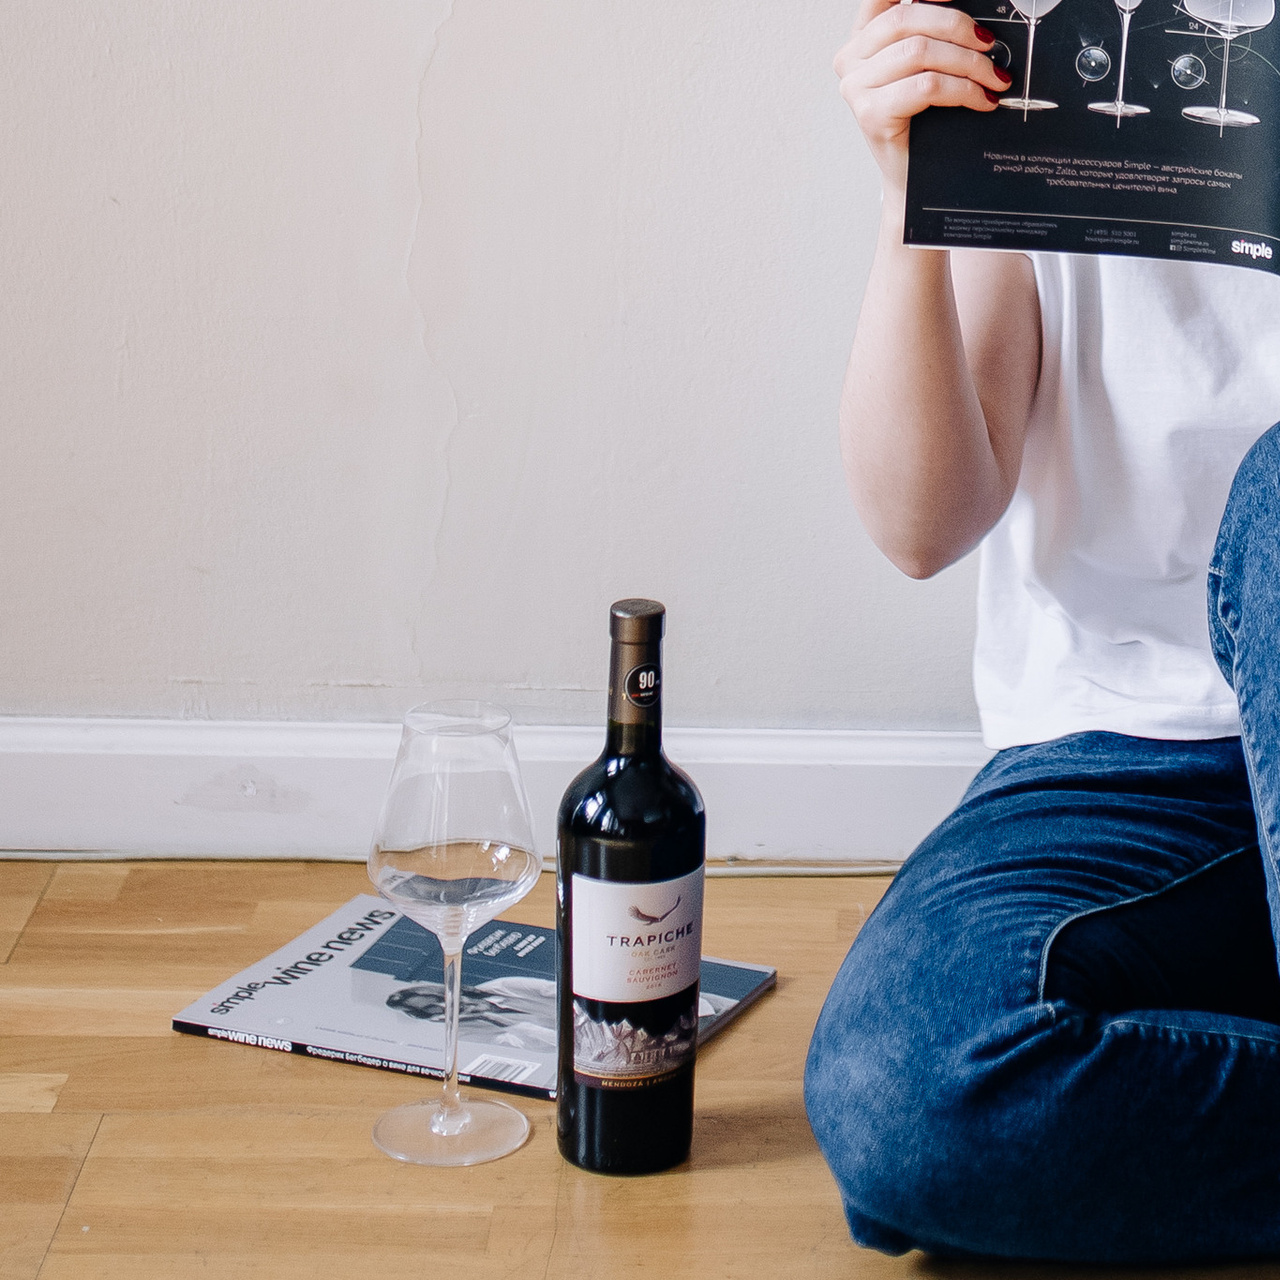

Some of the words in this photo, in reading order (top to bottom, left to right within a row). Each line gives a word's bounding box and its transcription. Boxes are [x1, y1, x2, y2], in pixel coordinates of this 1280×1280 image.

[983, 151, 1019, 161] Новинка
[1027, 155, 1071, 164] коллекции
[1072, 158, 1122, 168] аксессуаров
[1124, 160, 1151, 171] Simple
[1161, 165, 1212, 176] австрийские
[1214, 168, 1243, 180] бокалы
[993, 164, 1022, 173] ручной
[1025, 165, 1054, 174] работы
[1115, 172, 1169, 183] удовлетворят
[1171, 176, 1205, 186] запросы
[1207, 180, 1231, 189] самых
[1046, 177, 1111, 189] требовательных
[1231, 239, 1273, 260] simple
[639, 671, 655, 689] 90
[606, 921, 694, 947] TRAPICHE
[210, 982, 266, 1015] simple
[264, 951, 334, 986] wine
[322, 909, 396, 951] news
[629, 962, 677, 976] CABERNET
[626, 970, 679, 984] SAUVIGNON
[227, 1030, 257, 1046] wine
[258, 1036, 293, 1052] news
[601, 1080, 643, 1088] MENDOZA
